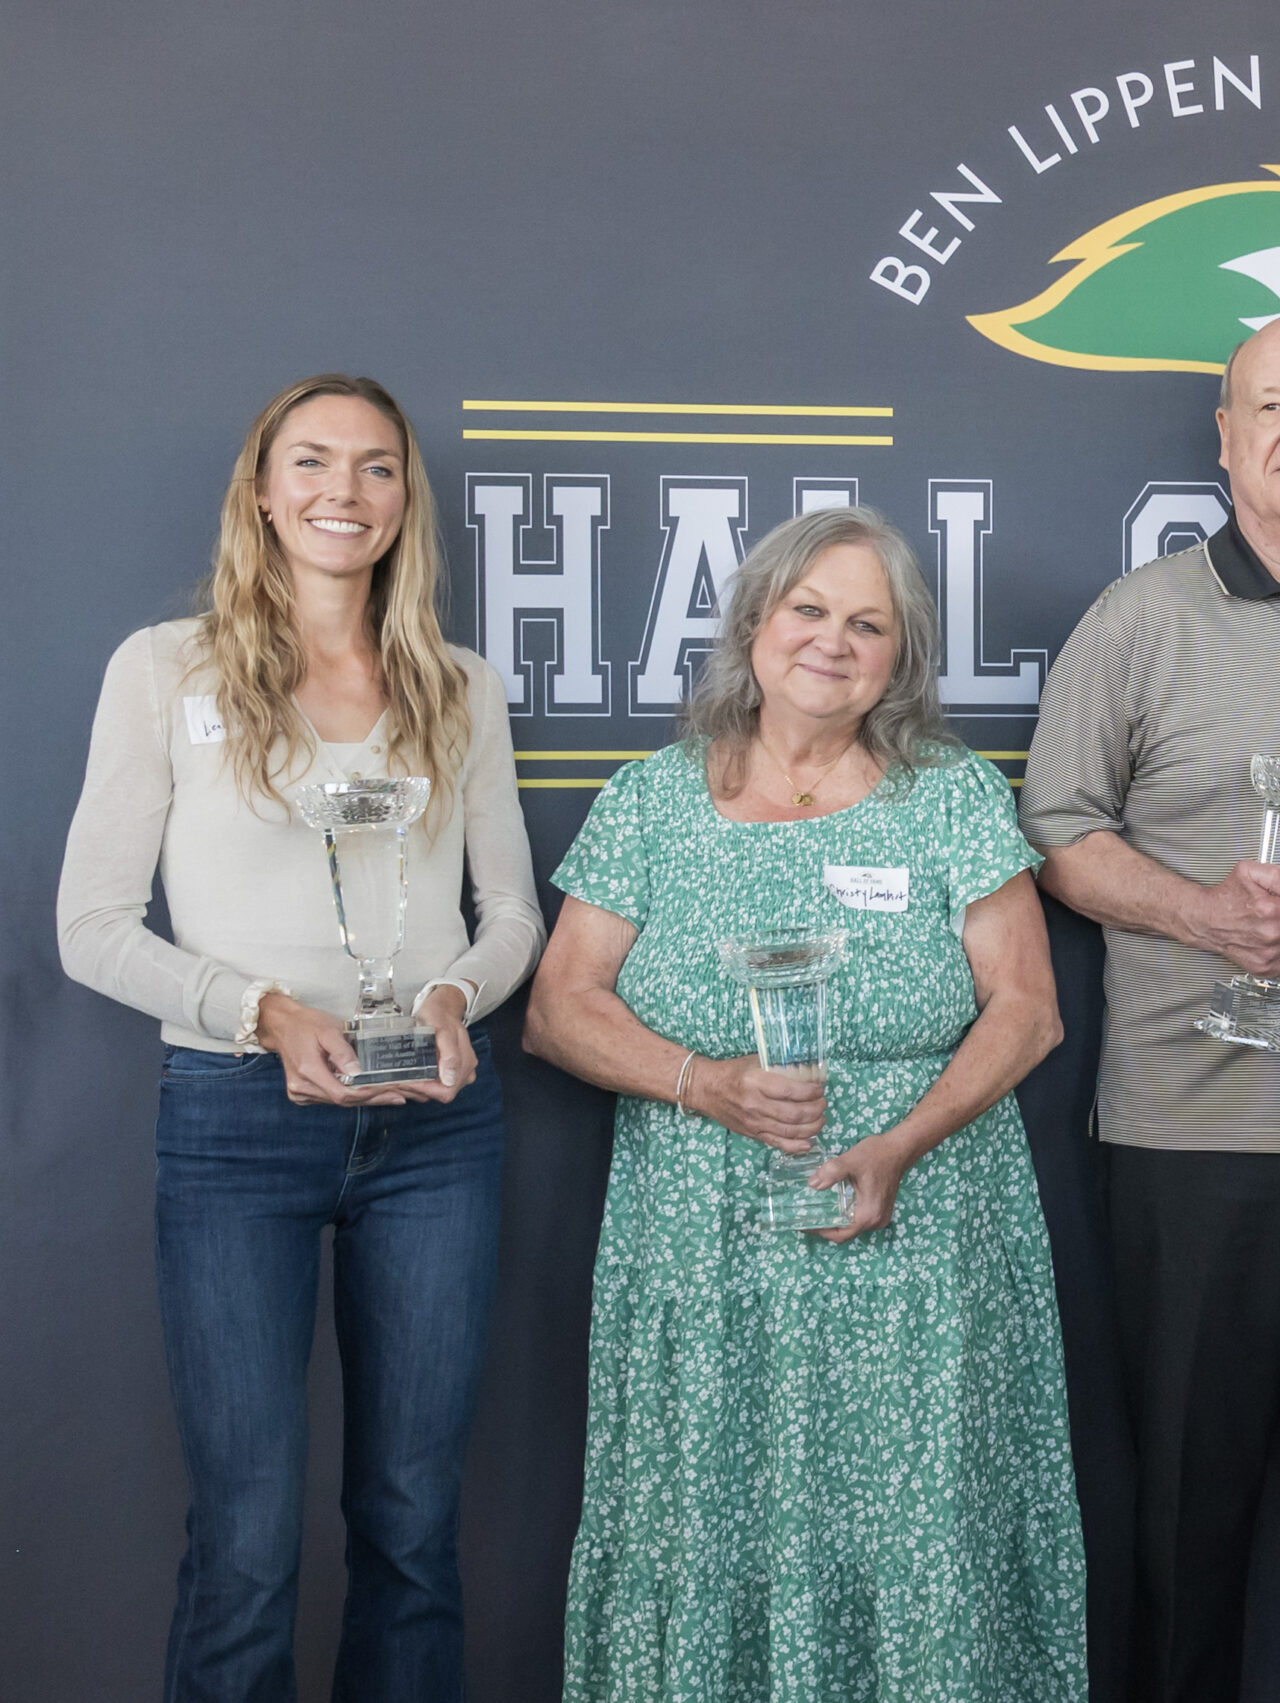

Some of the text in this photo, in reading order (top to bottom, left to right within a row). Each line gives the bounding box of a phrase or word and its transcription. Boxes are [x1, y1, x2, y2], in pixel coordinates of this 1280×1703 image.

[869, 163, 1003, 305] BEN
[1007, 55, 1262, 174] LIPPEN
[465, 472, 1048, 718] HAL
